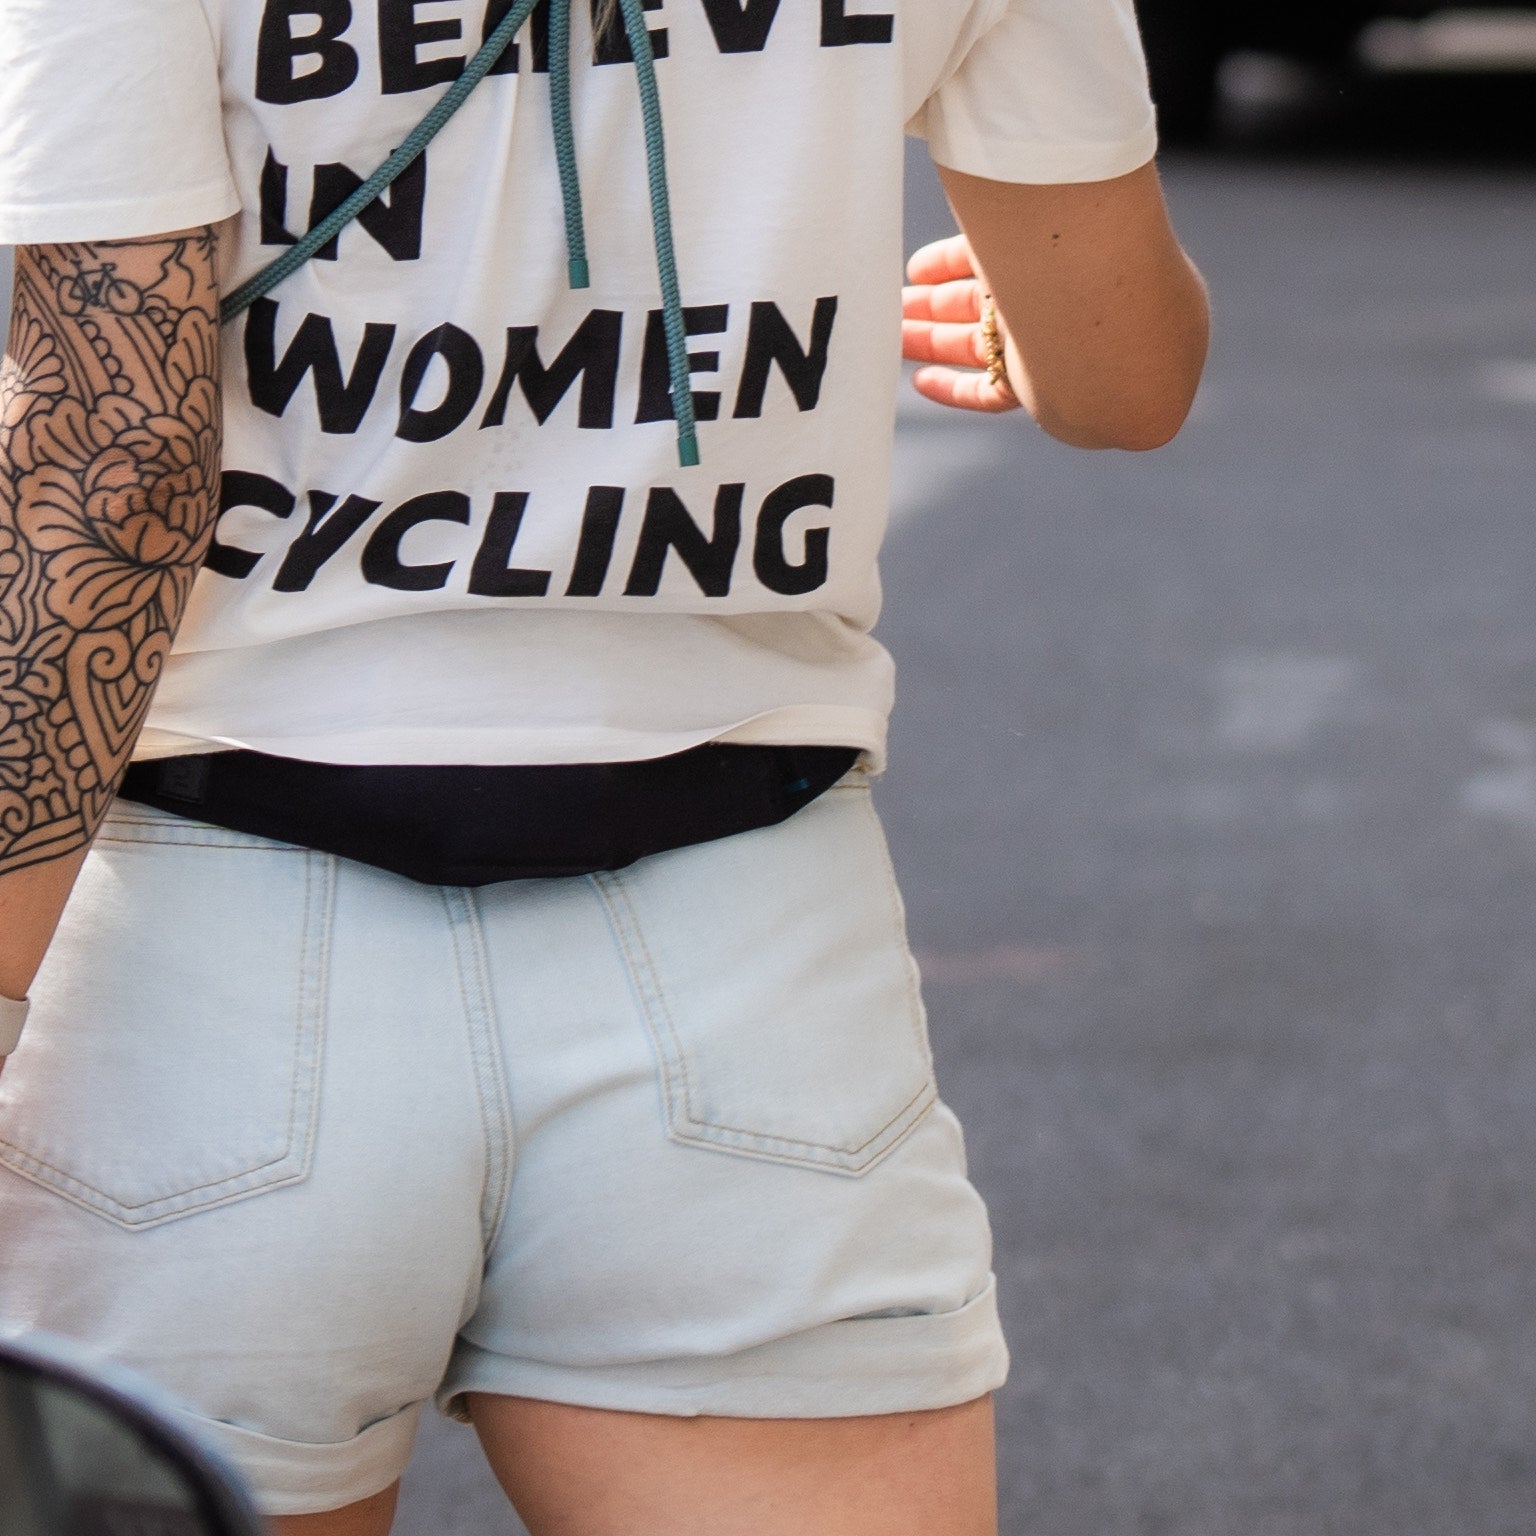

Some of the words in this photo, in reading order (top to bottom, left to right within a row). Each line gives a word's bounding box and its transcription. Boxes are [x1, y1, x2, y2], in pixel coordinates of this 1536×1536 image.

[260, 144, 426, 261] IN
[244, 295, 837, 444] WOMEN
[201, 470, 834, 598] CYCLING
